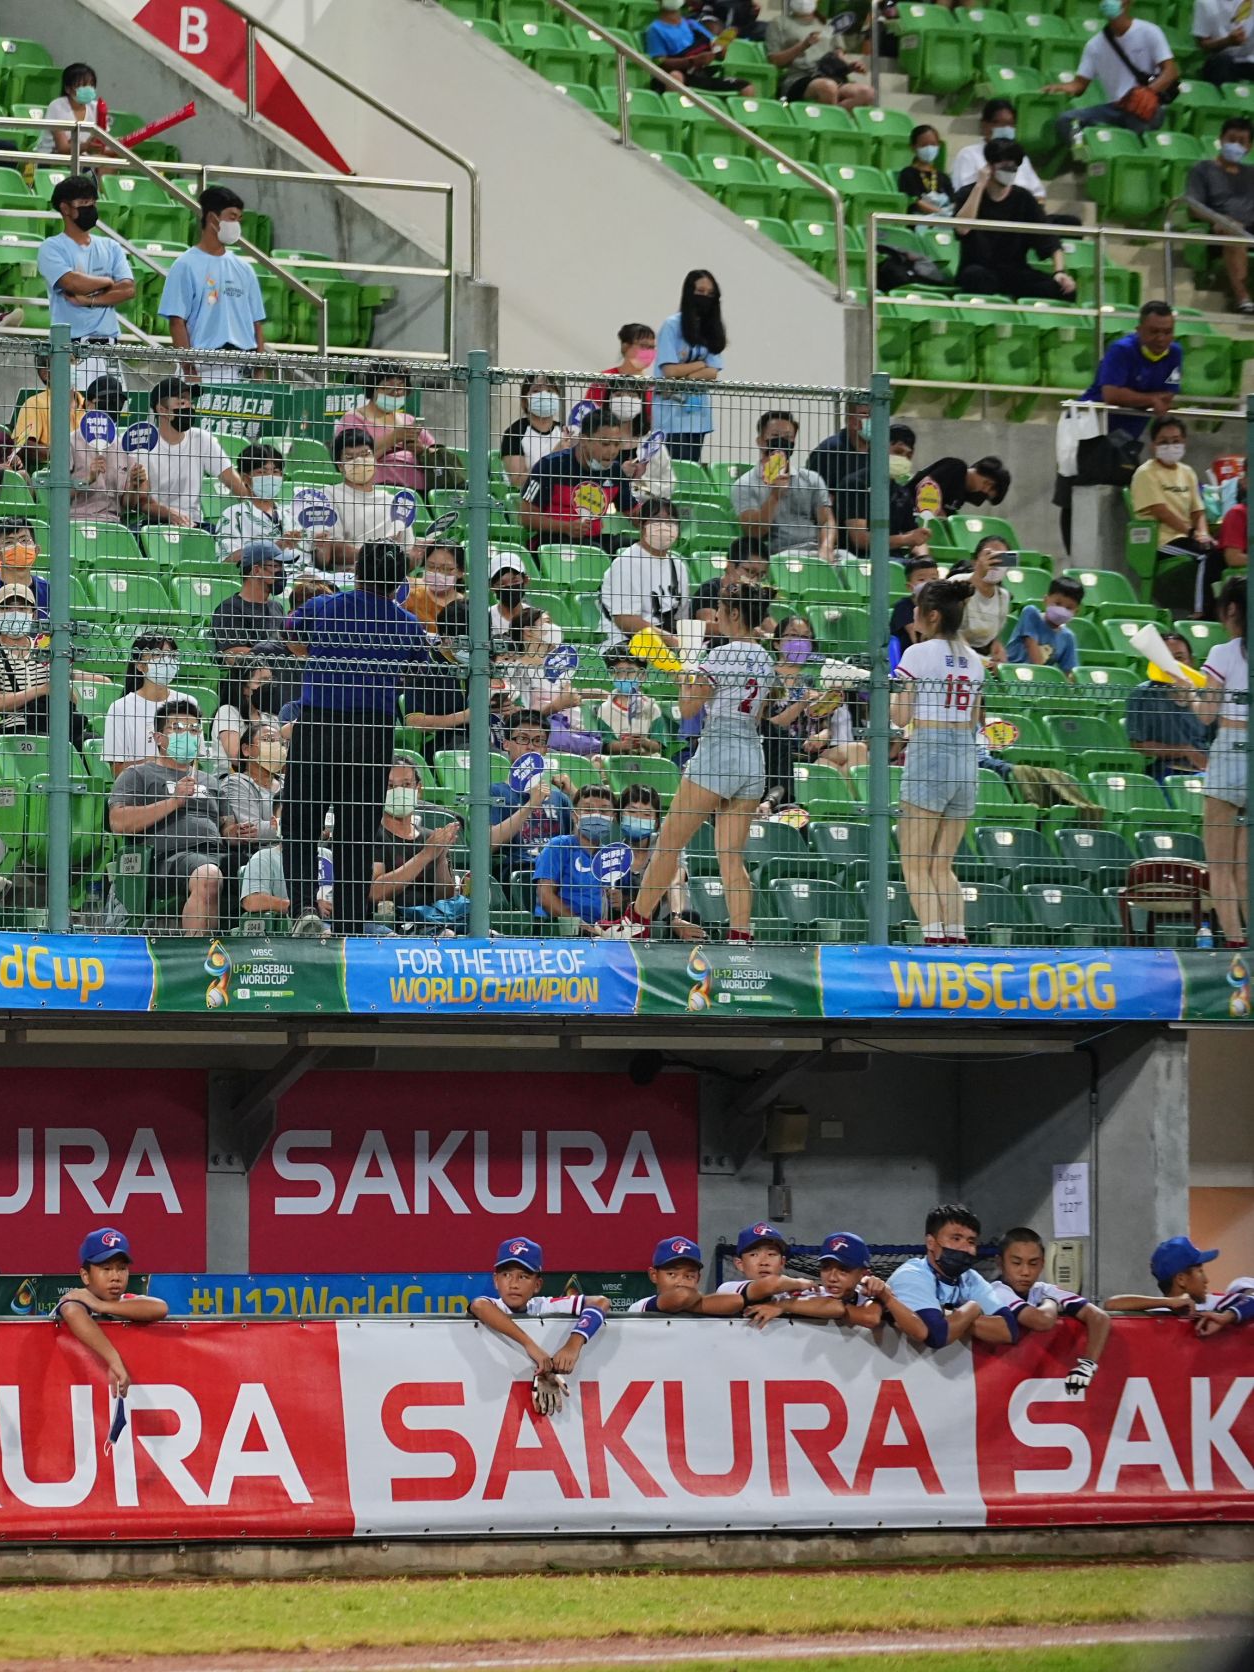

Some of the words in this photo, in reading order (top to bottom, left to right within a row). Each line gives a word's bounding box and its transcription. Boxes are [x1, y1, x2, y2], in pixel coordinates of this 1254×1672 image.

[178, 6, 209, 54] B
[738, 678, 757, 713] 2
[944, 674, 970, 711] 16
[251, 949, 273, 957] WBSC
[395, 949, 444, 975] FOR
[445, 949, 494, 975] THE
[494, 949, 553, 975] TITLE
[556, 949, 586, 975] OF
[729, 955, 751, 963] WBSC
[233, 965, 251, 974] U-12
[252, 964, 294, 974] BASEBALL
[240, 975, 271, 985] WORLD
[272, 975, 288, 985] CUP
[714, 969, 732, 979] U-12
[732, 969, 772, 980] BASEBALL
[389, 977, 478, 1003] WORLD
[480, 976, 599, 1003] CHAMPION
[721, 980, 750, 989] WORLD
[750, 980, 765, 990] CUP
[889, 961, 1117, 1010] WBSC.ORG
[271, 1129, 676, 1215] SAKURA
[381, 1380, 946, 1502] SAKURA
[1008, 1376, 1254, 1494] SAK
